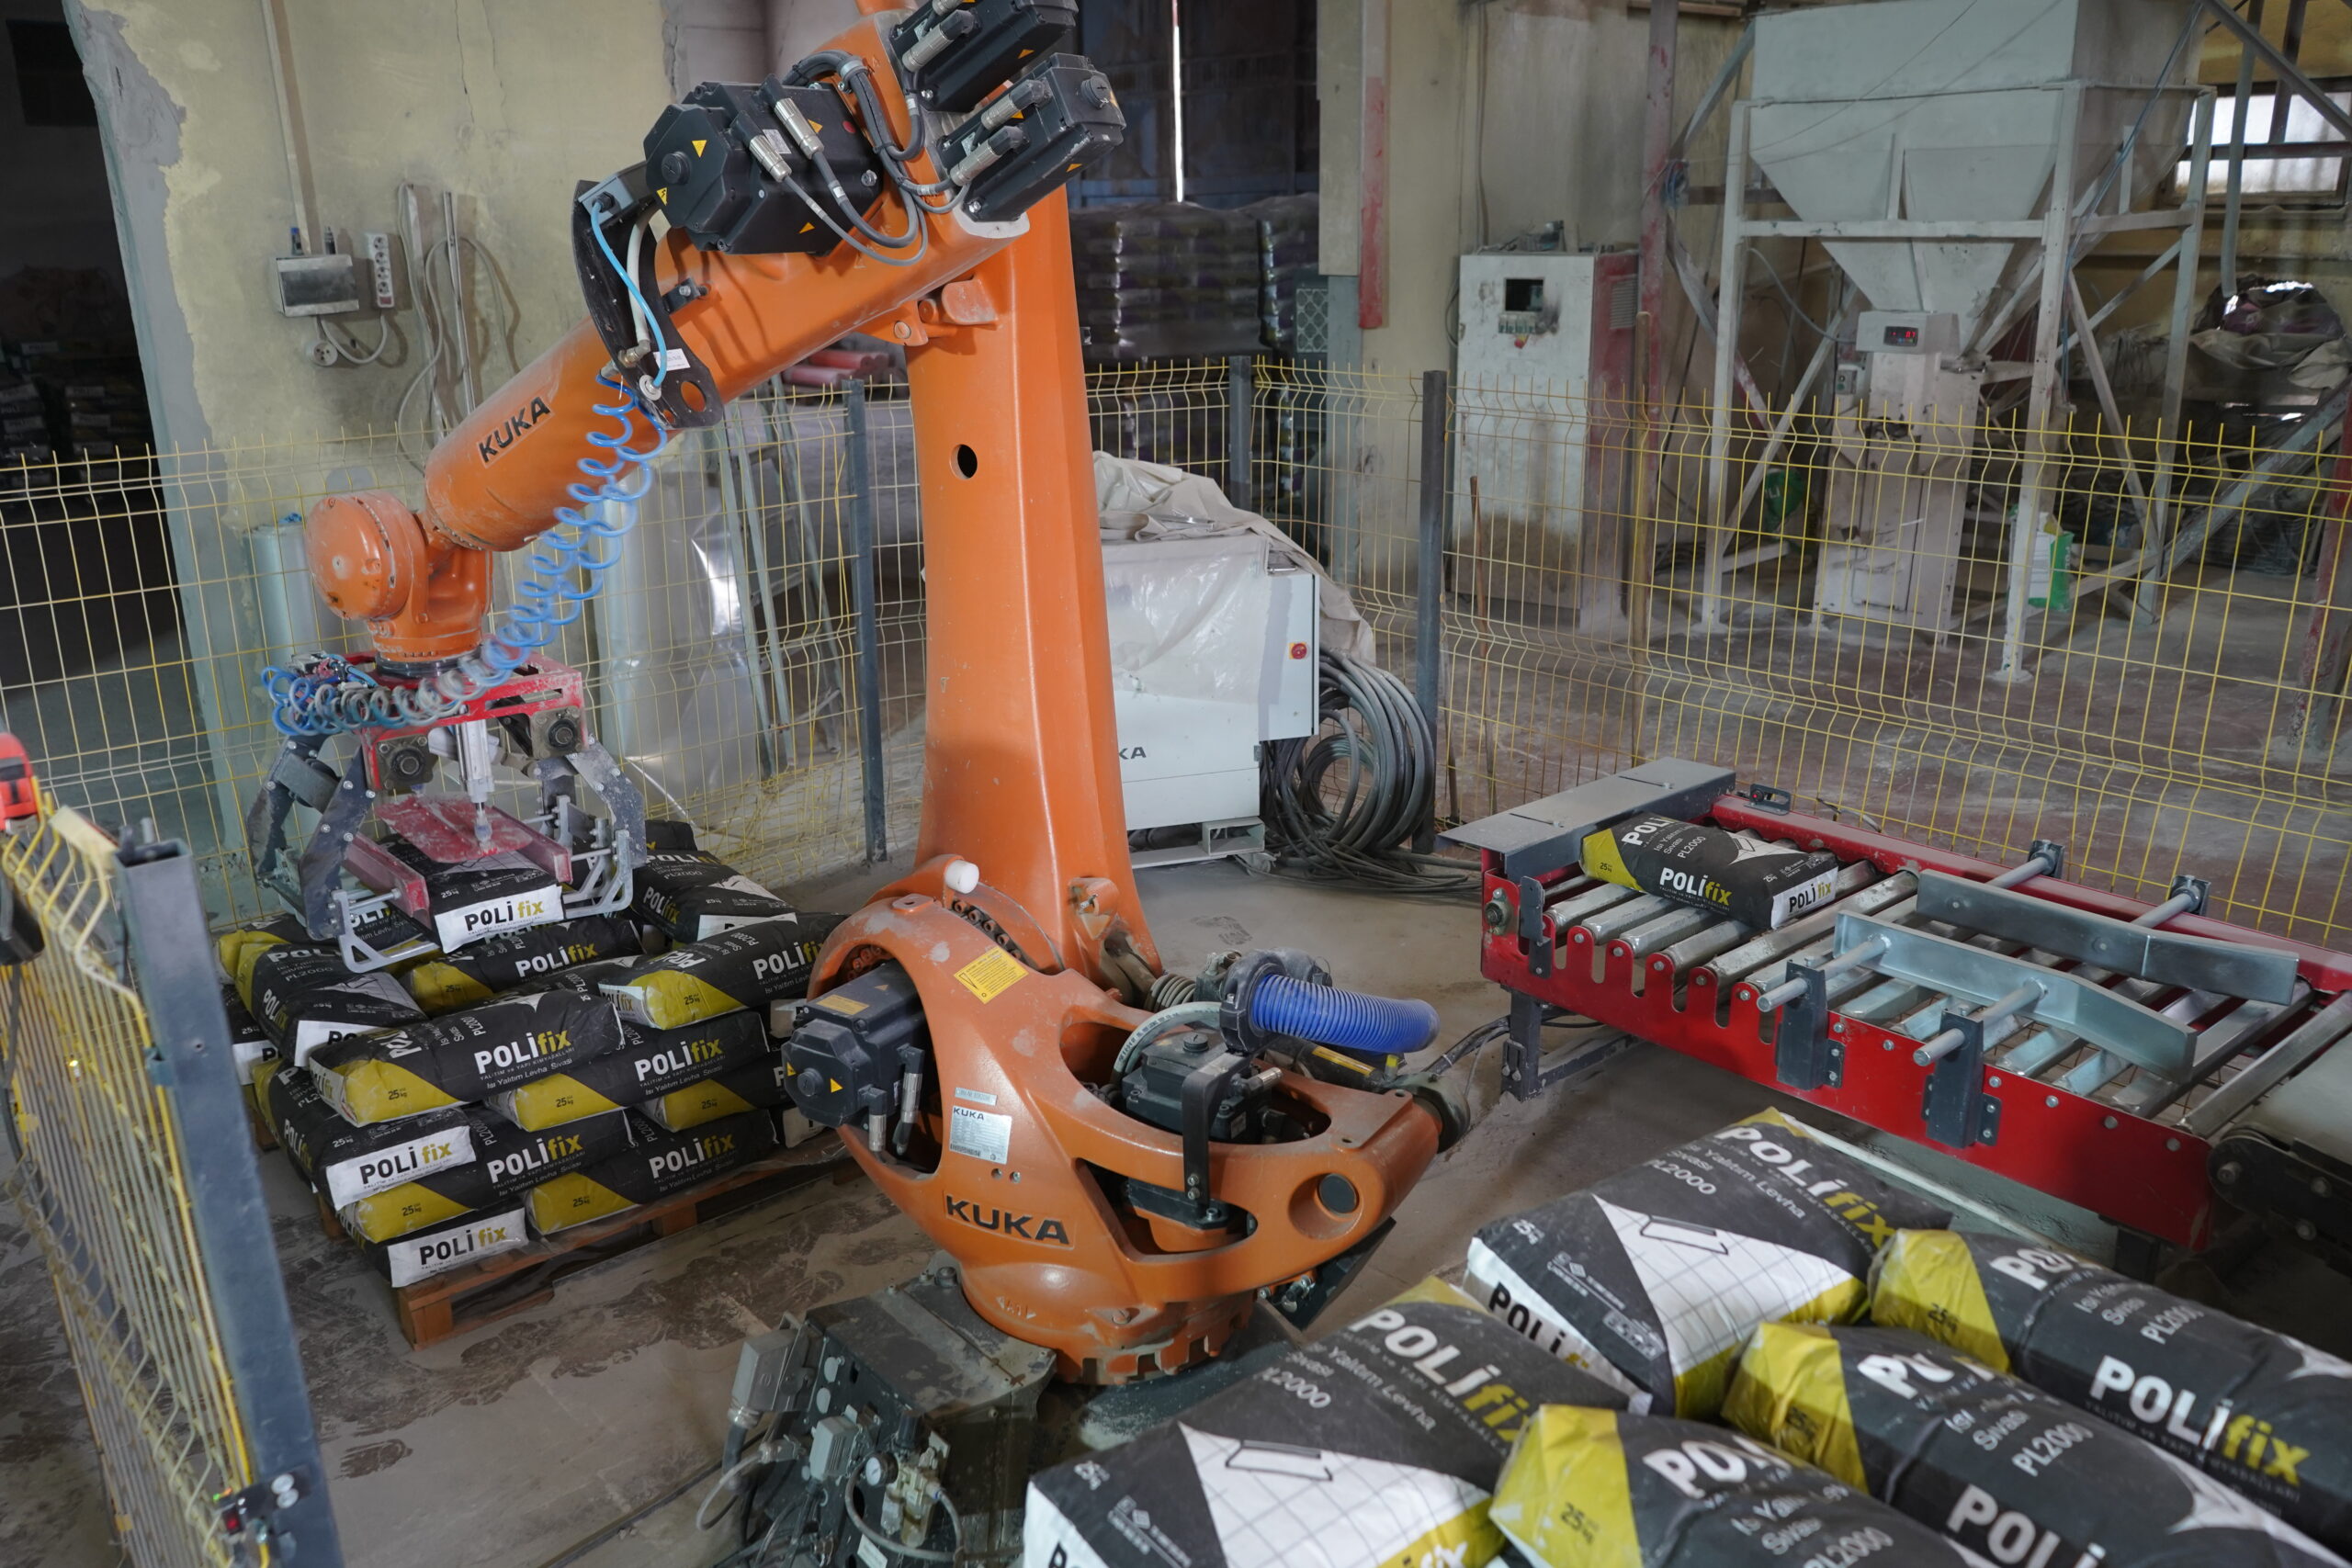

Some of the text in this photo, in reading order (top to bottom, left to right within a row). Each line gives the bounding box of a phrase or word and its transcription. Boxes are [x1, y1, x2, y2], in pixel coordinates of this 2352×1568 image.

[478, 397, 551, 463] KUKA
[1118, 747, 1147, 761] KA
[1678, 836, 1706, 859] PL2000
[525, 1066, 548, 1079] Levha
[953, 1107, 984, 1121] KUKA
[1756, 1181, 1806, 1219] Levha
[946, 1195, 1070, 1246] KUKA
[1382, 1385, 1437, 1432] Levha
